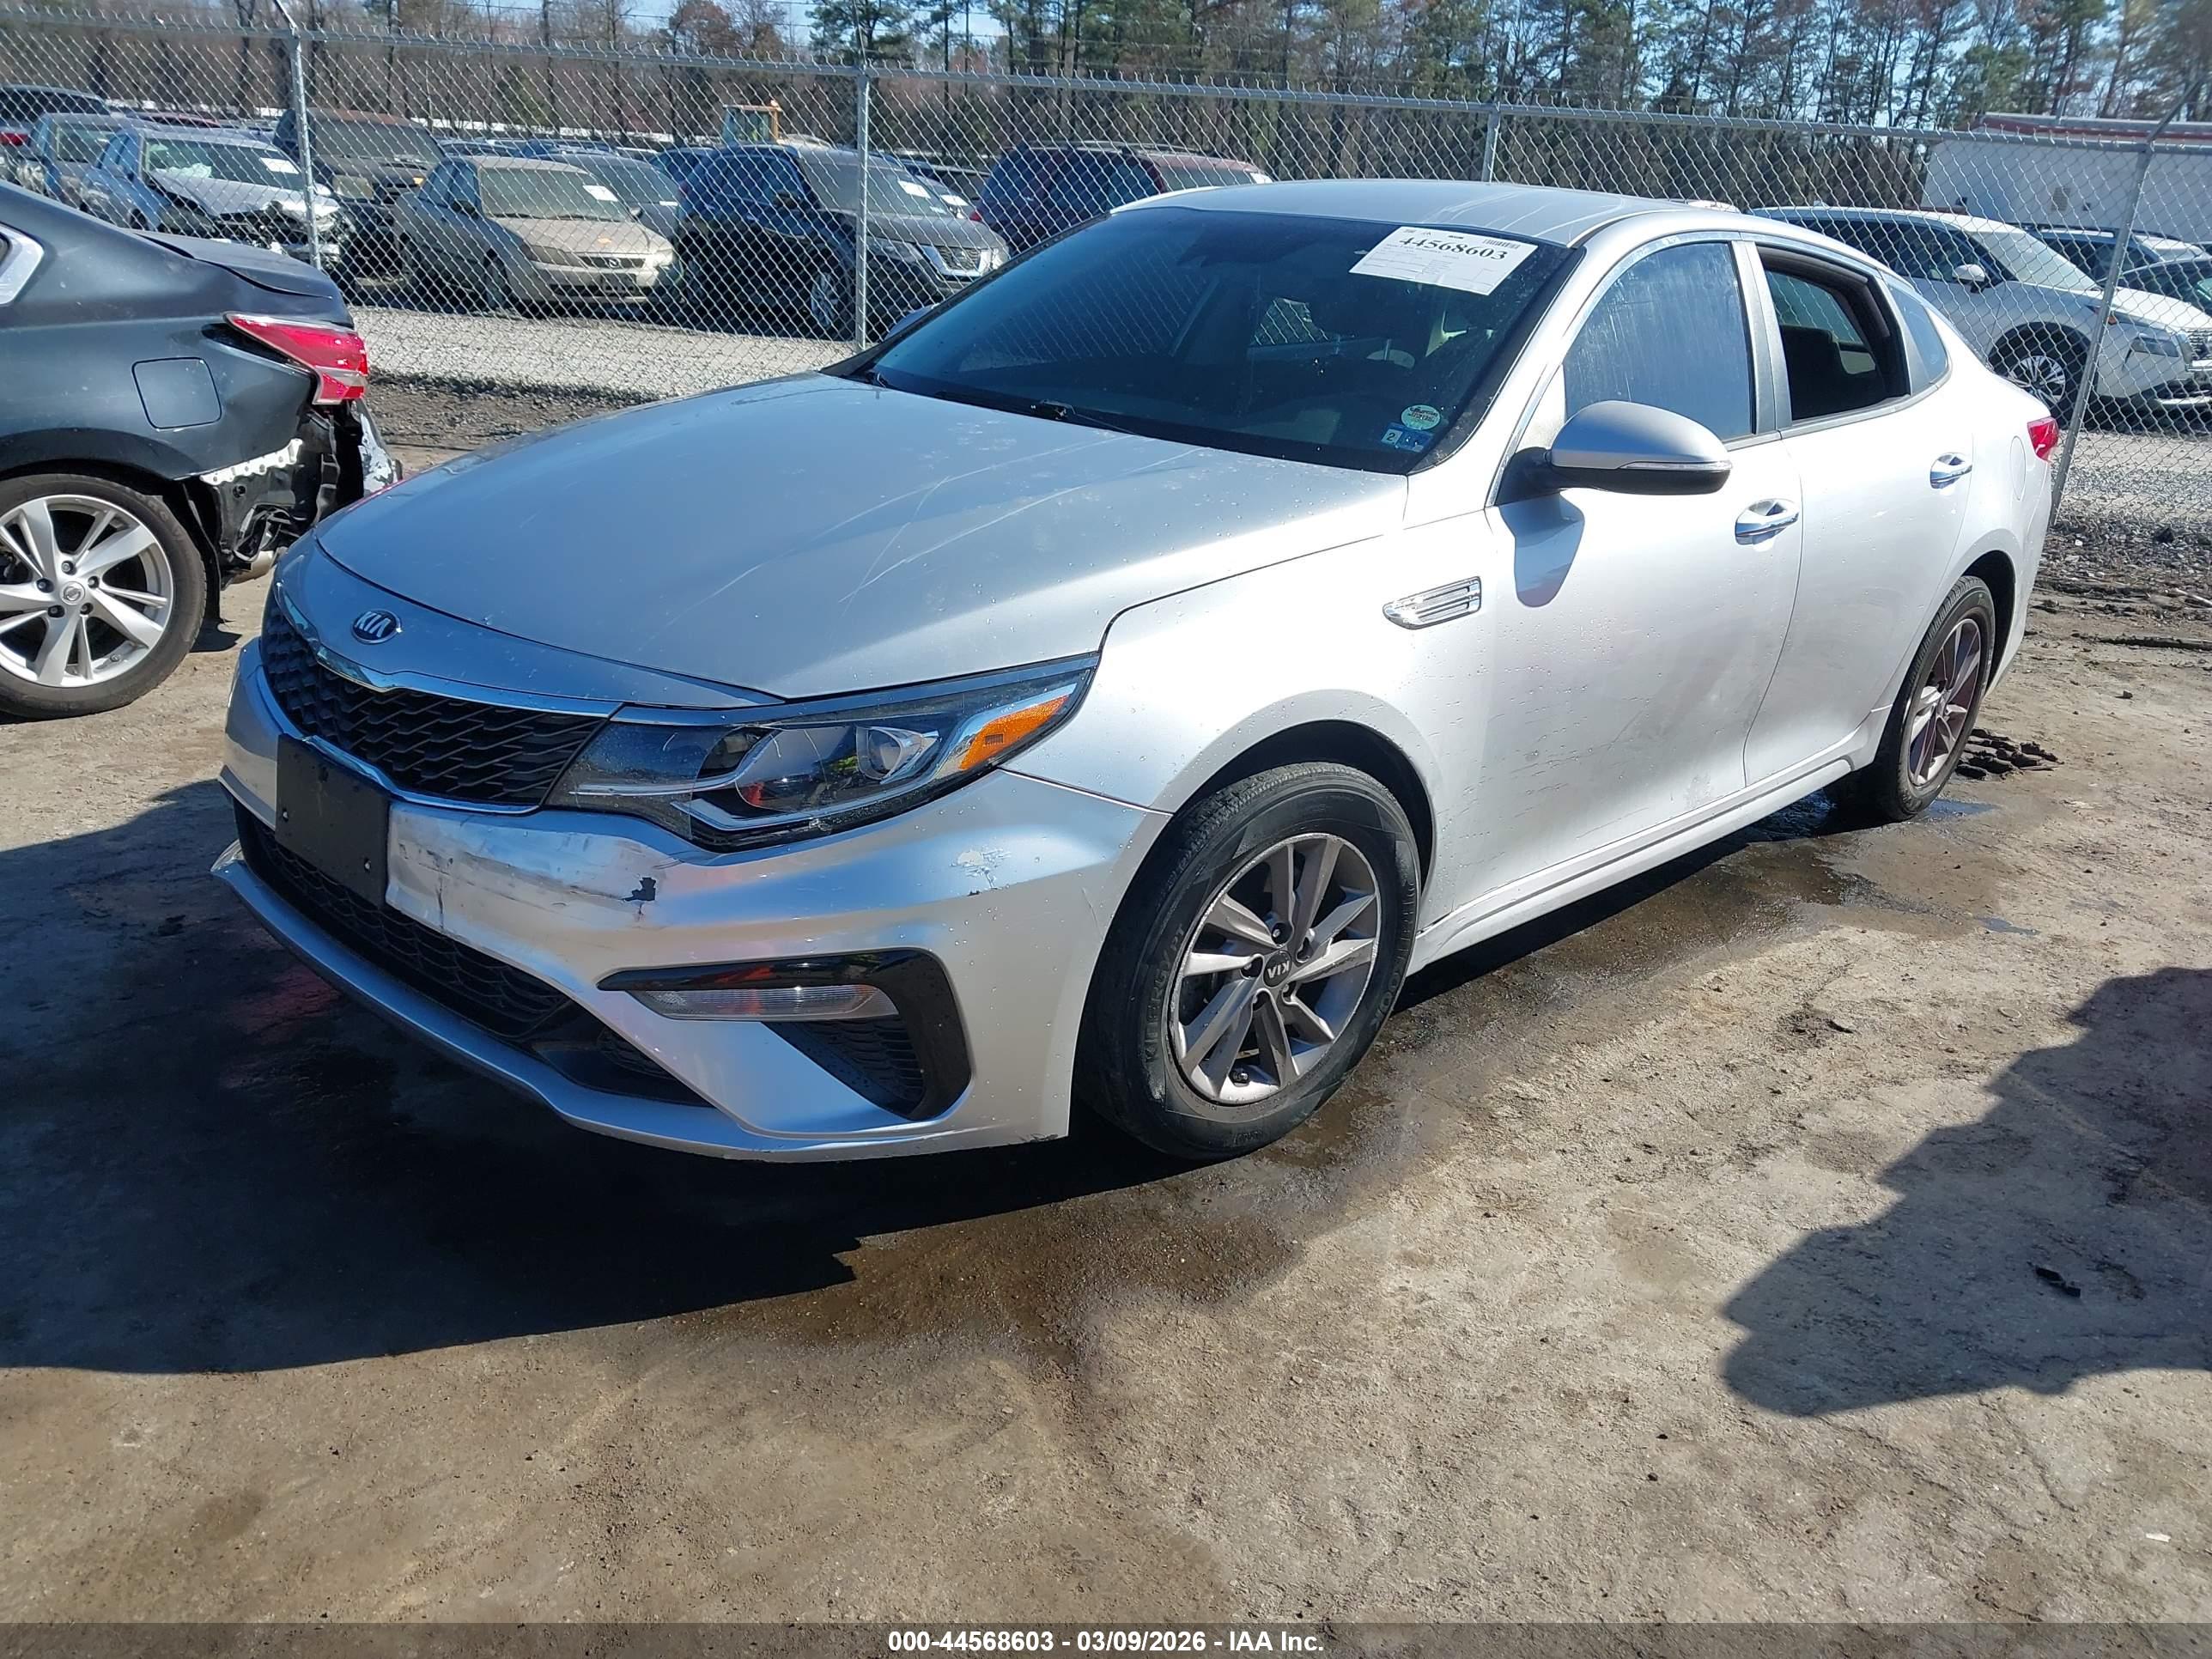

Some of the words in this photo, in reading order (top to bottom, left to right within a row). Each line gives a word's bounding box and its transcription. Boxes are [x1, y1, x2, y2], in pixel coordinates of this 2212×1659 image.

[1399, 237, 1508, 260] 44568603
[354, 611, 392, 638] KIA
[1267, 960, 1290, 979] KIA
